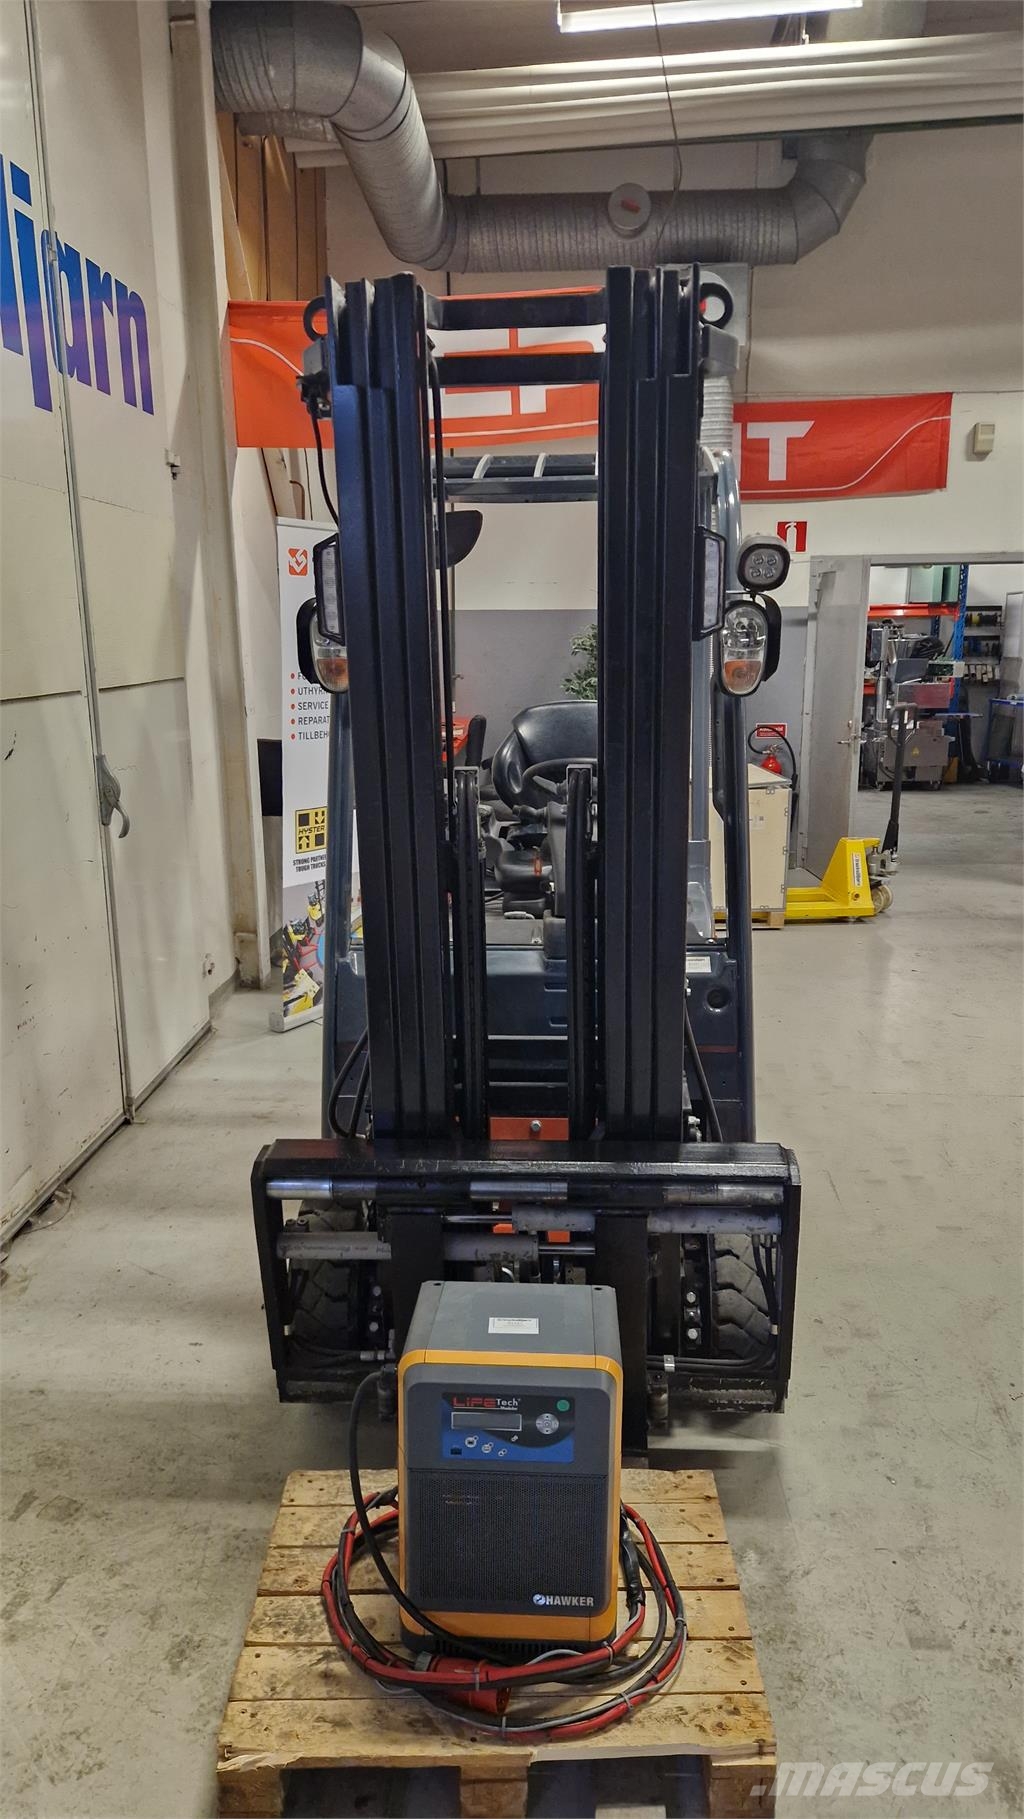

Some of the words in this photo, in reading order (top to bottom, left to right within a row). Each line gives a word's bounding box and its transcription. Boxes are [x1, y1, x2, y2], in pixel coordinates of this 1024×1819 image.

[297, 687, 327, 696] UTHYR
[297, 701, 329, 711] SERVICE
[298, 825, 325, 835] HYSTER
[546, 1594, 594, 1607] HAWKER
